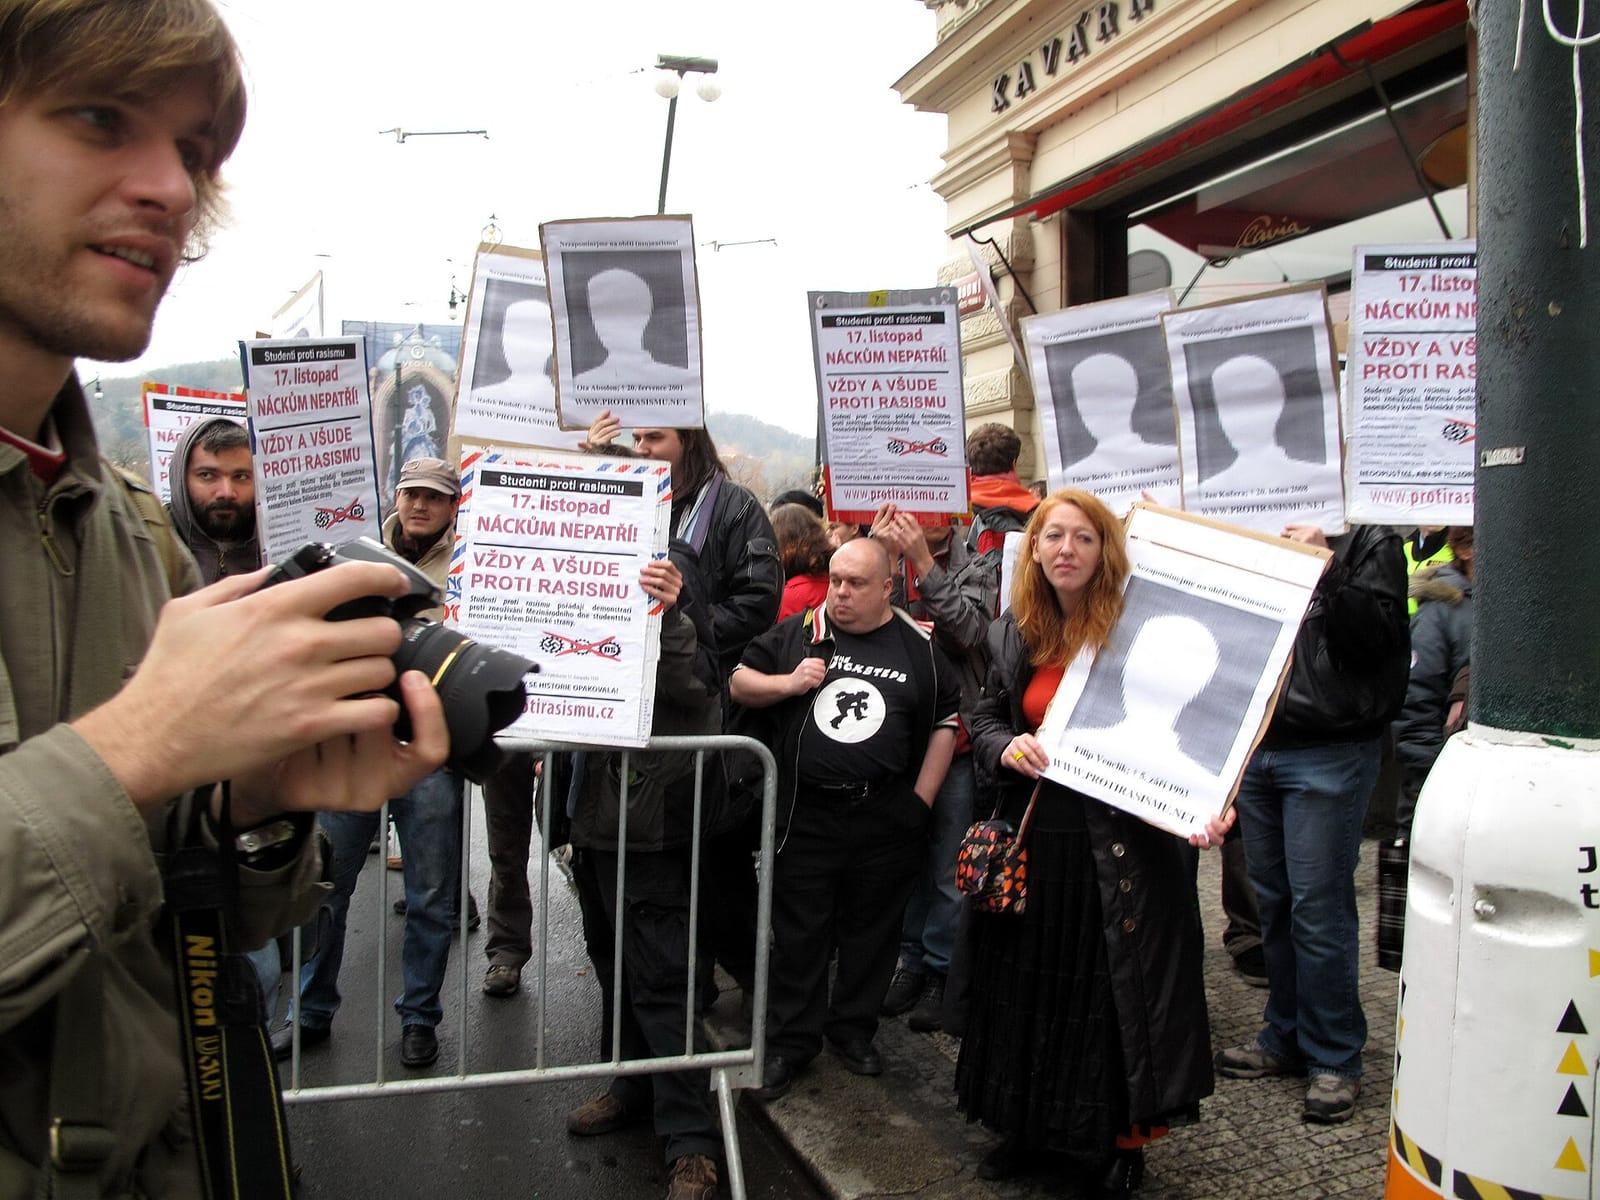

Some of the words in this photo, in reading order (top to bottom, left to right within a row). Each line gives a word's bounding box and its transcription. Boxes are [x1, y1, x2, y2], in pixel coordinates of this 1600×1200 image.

[991, 0, 1156, 114] KAVÁRN
[1384, 256, 1438, 269] Studenti
[1440, 255, 1470, 269] proti
[1399, 276, 1426, 292] 17.
[1430, 274, 1477, 294] listo
[1364, 298, 1450, 320] NÁCKŮM
[836, 315, 872, 327] Studenti
[874, 314, 895, 326] proti
[896, 314, 931, 324] rasismu
[847, 331, 866, 344] 17.
[869, 328, 923, 346] listopad
[1363, 337, 1420, 357] VŽDY
[1427, 341, 1442, 357] A
[264, 350, 296, 362] Studenti
[298, 349, 316, 362] proti
[316, 348, 345, 358] rasismu
[826, 347, 887, 366] NÁCKŮM
[888, 346, 947, 364] NEPATŘÍ!
[274, 369, 292, 386] 17.
[294, 364, 339, 387] listopad
[1363, 364, 1428, 380] PROTI
[828, 376, 866, 393] VŽDY
[872, 379, 882, 391] A
[886, 376, 938, 391] VŠUDE
[257, 392, 308, 417] NÁCKŮM
[310, 386, 359, 410] NEPATŘÍ!
[830, 396, 874, 409] PROTI
[879, 396, 946, 409] RASISMU
[177, 416, 192, 427] 17
[222, 408, 246, 417] rasism
[470, 408, 555, 428] WWW.PROTIRASISM
[261, 433, 293, 456] VŽDY
[298, 437, 307, 450] A
[310, 426, 352, 447] VŠUDE
[263, 457, 301, 479] PROTI
[305, 447, 360, 471] RASISMU
[500, 474, 546, 490] Studenti
[550, 478, 577, 492] proti
[578, 481, 626, 494] rasismu
[1093, 478, 1180, 496] PROTIRASISMU.NET
[511, 493, 536, 510] 17.
[540, 495, 611, 517] listopad
[844, 488, 950, 502] www.protirasismu.cz
[1370, 488, 1475, 507] www.protirasi
[476, 514, 556, 538] NÁCKŮM
[560, 520, 638, 543] NEPATŘÍ!
[472, 550, 527, 570] VŽDY
[530, 556, 546, 572] A
[552, 556, 620, 578] VŠUDE
[470, 573, 532, 593] PROTI
[538, 579, 630, 600] RASISMU
[468, 604, 486, 612] proti
[470, 594, 498, 604] Studenti
[502, 598, 520, 606] proti
[525, 600, 551, 608] rasismu
[504, 614, 525, 623] kolem
[540, 682, 572, 691] HISTORIE
[522, 698, 614, 720] otirasismu.cz
[1053, 758, 1198, 824] WWW.PROTIRASISMU.NET
[185, 935, 218, 1027] Nikon
